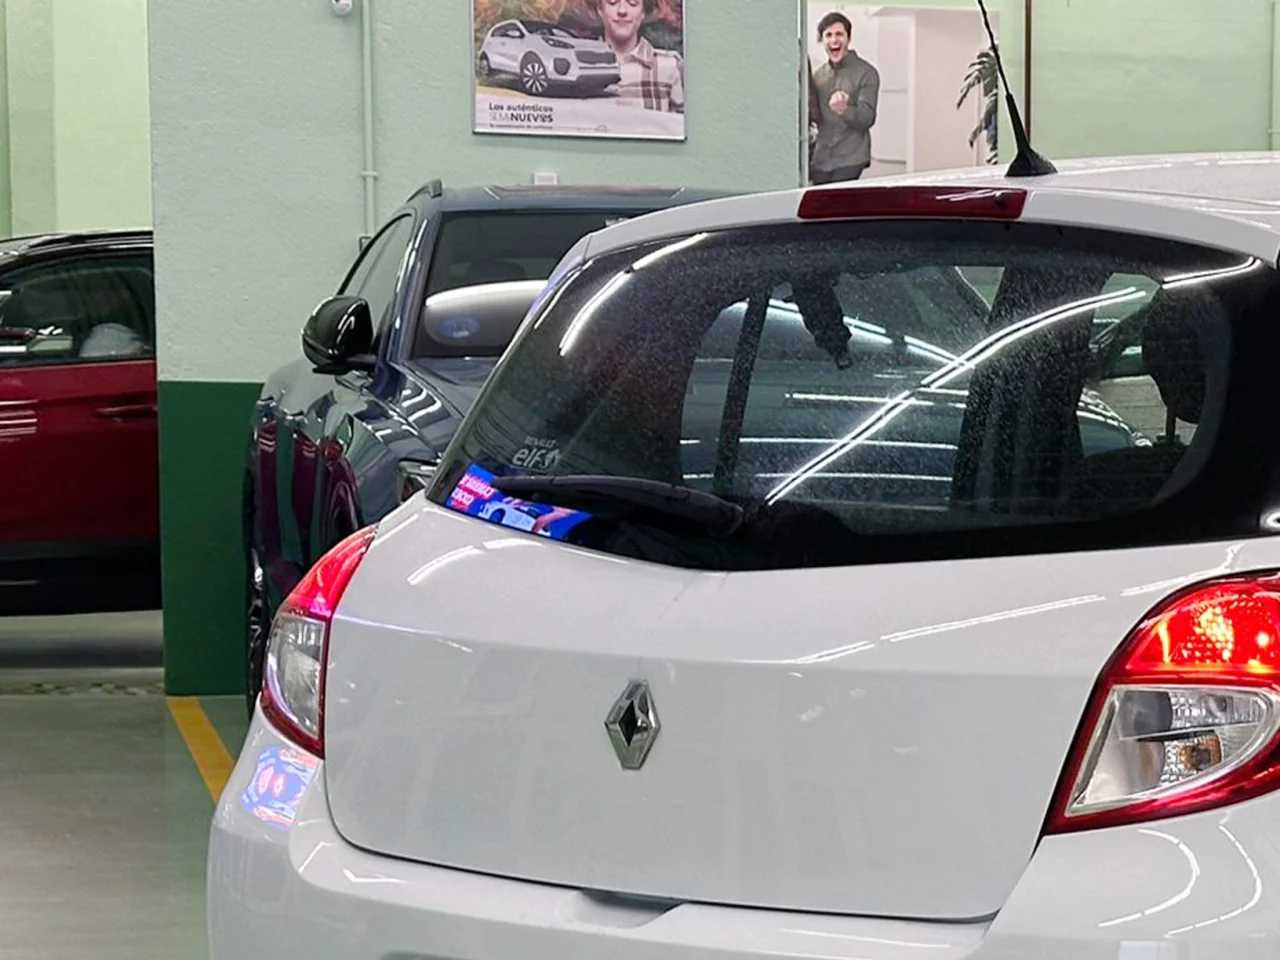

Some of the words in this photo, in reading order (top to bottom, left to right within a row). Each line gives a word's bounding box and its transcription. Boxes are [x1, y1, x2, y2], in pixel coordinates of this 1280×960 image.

[489, 101, 504, 111] Los
[506, 103, 554, 112] auténticos
[512, 449, 547, 468] elf
